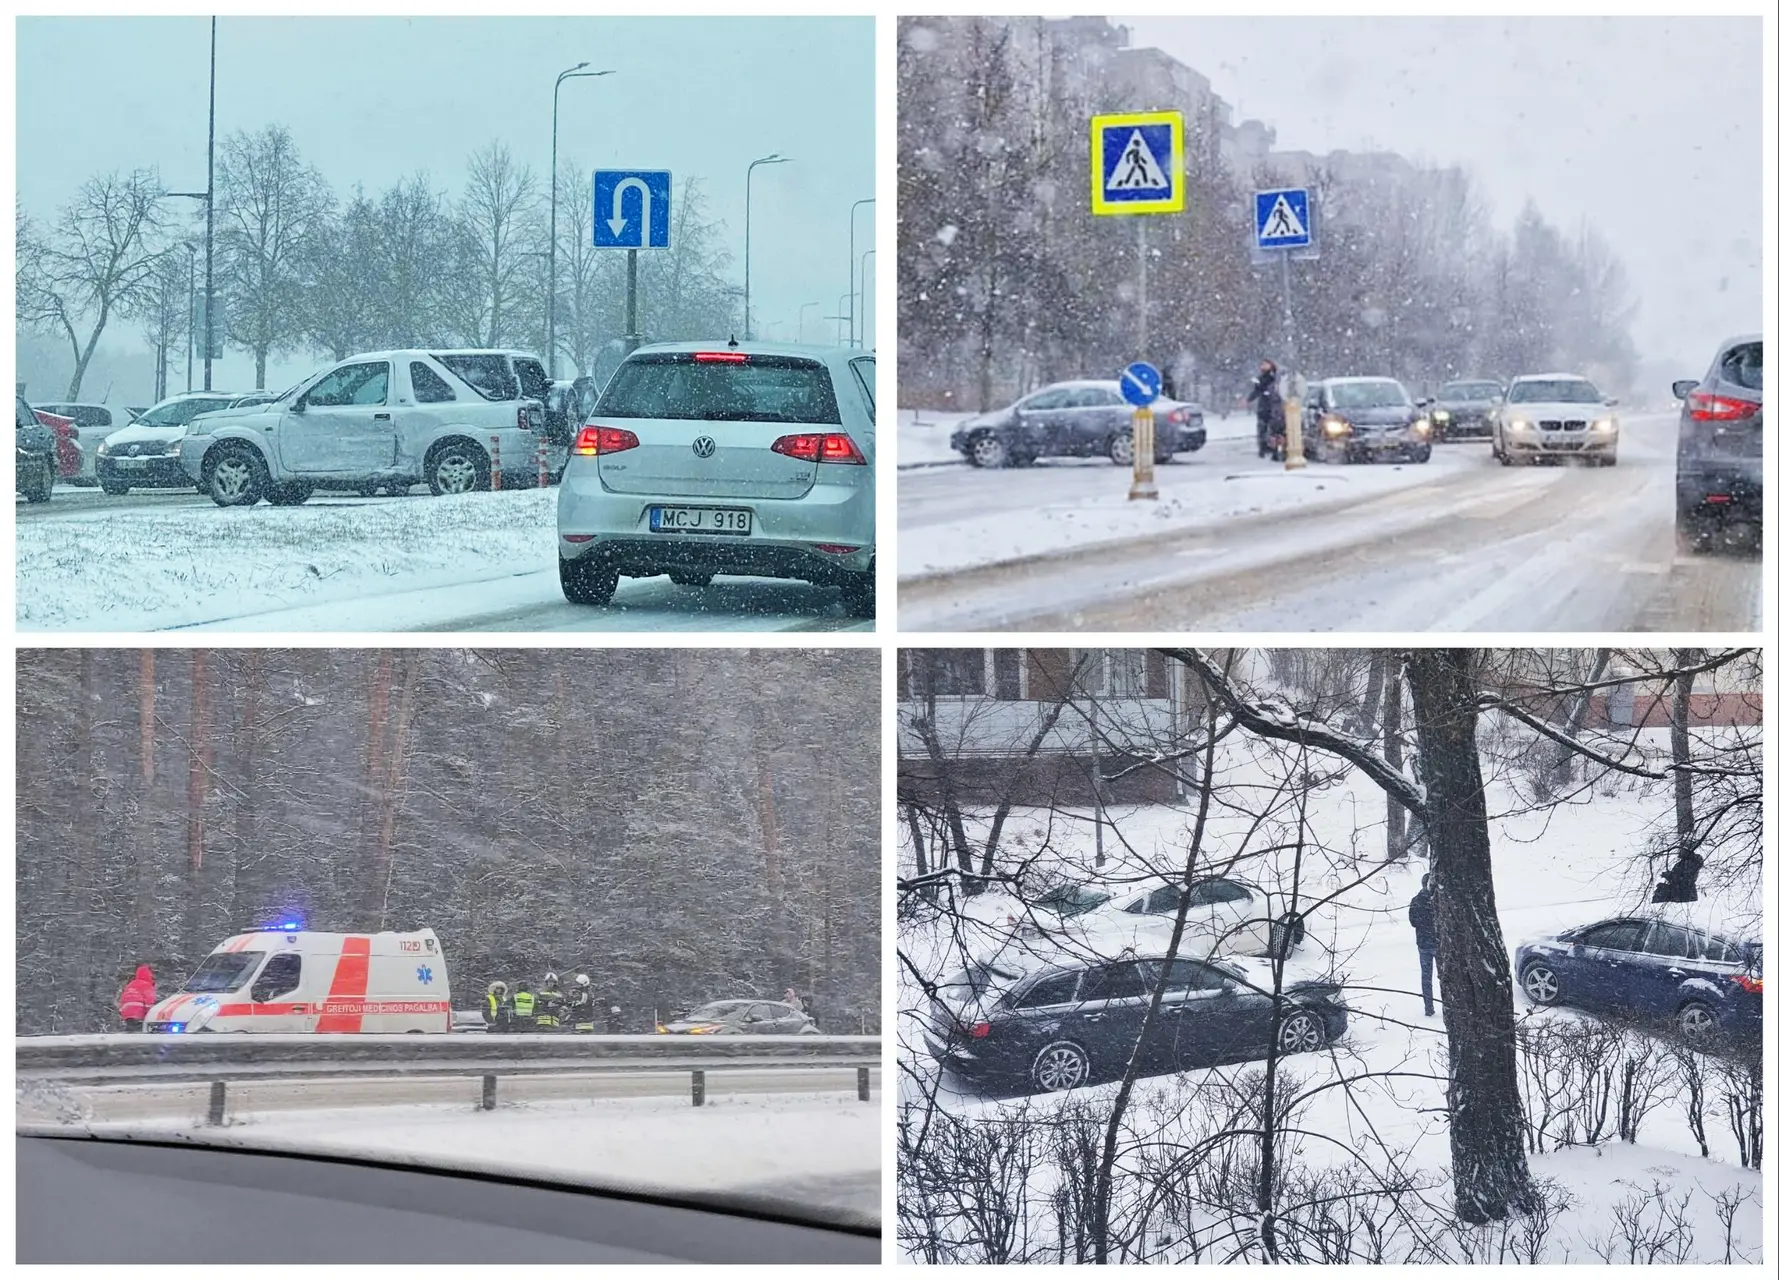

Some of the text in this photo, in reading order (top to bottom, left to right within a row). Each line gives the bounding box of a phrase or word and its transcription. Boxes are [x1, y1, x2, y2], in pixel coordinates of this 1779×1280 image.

[662, 510, 746, 529] MCJ 918
[326, 1003, 438, 1013] GREITOJI MEDICINOS PAGALBA
